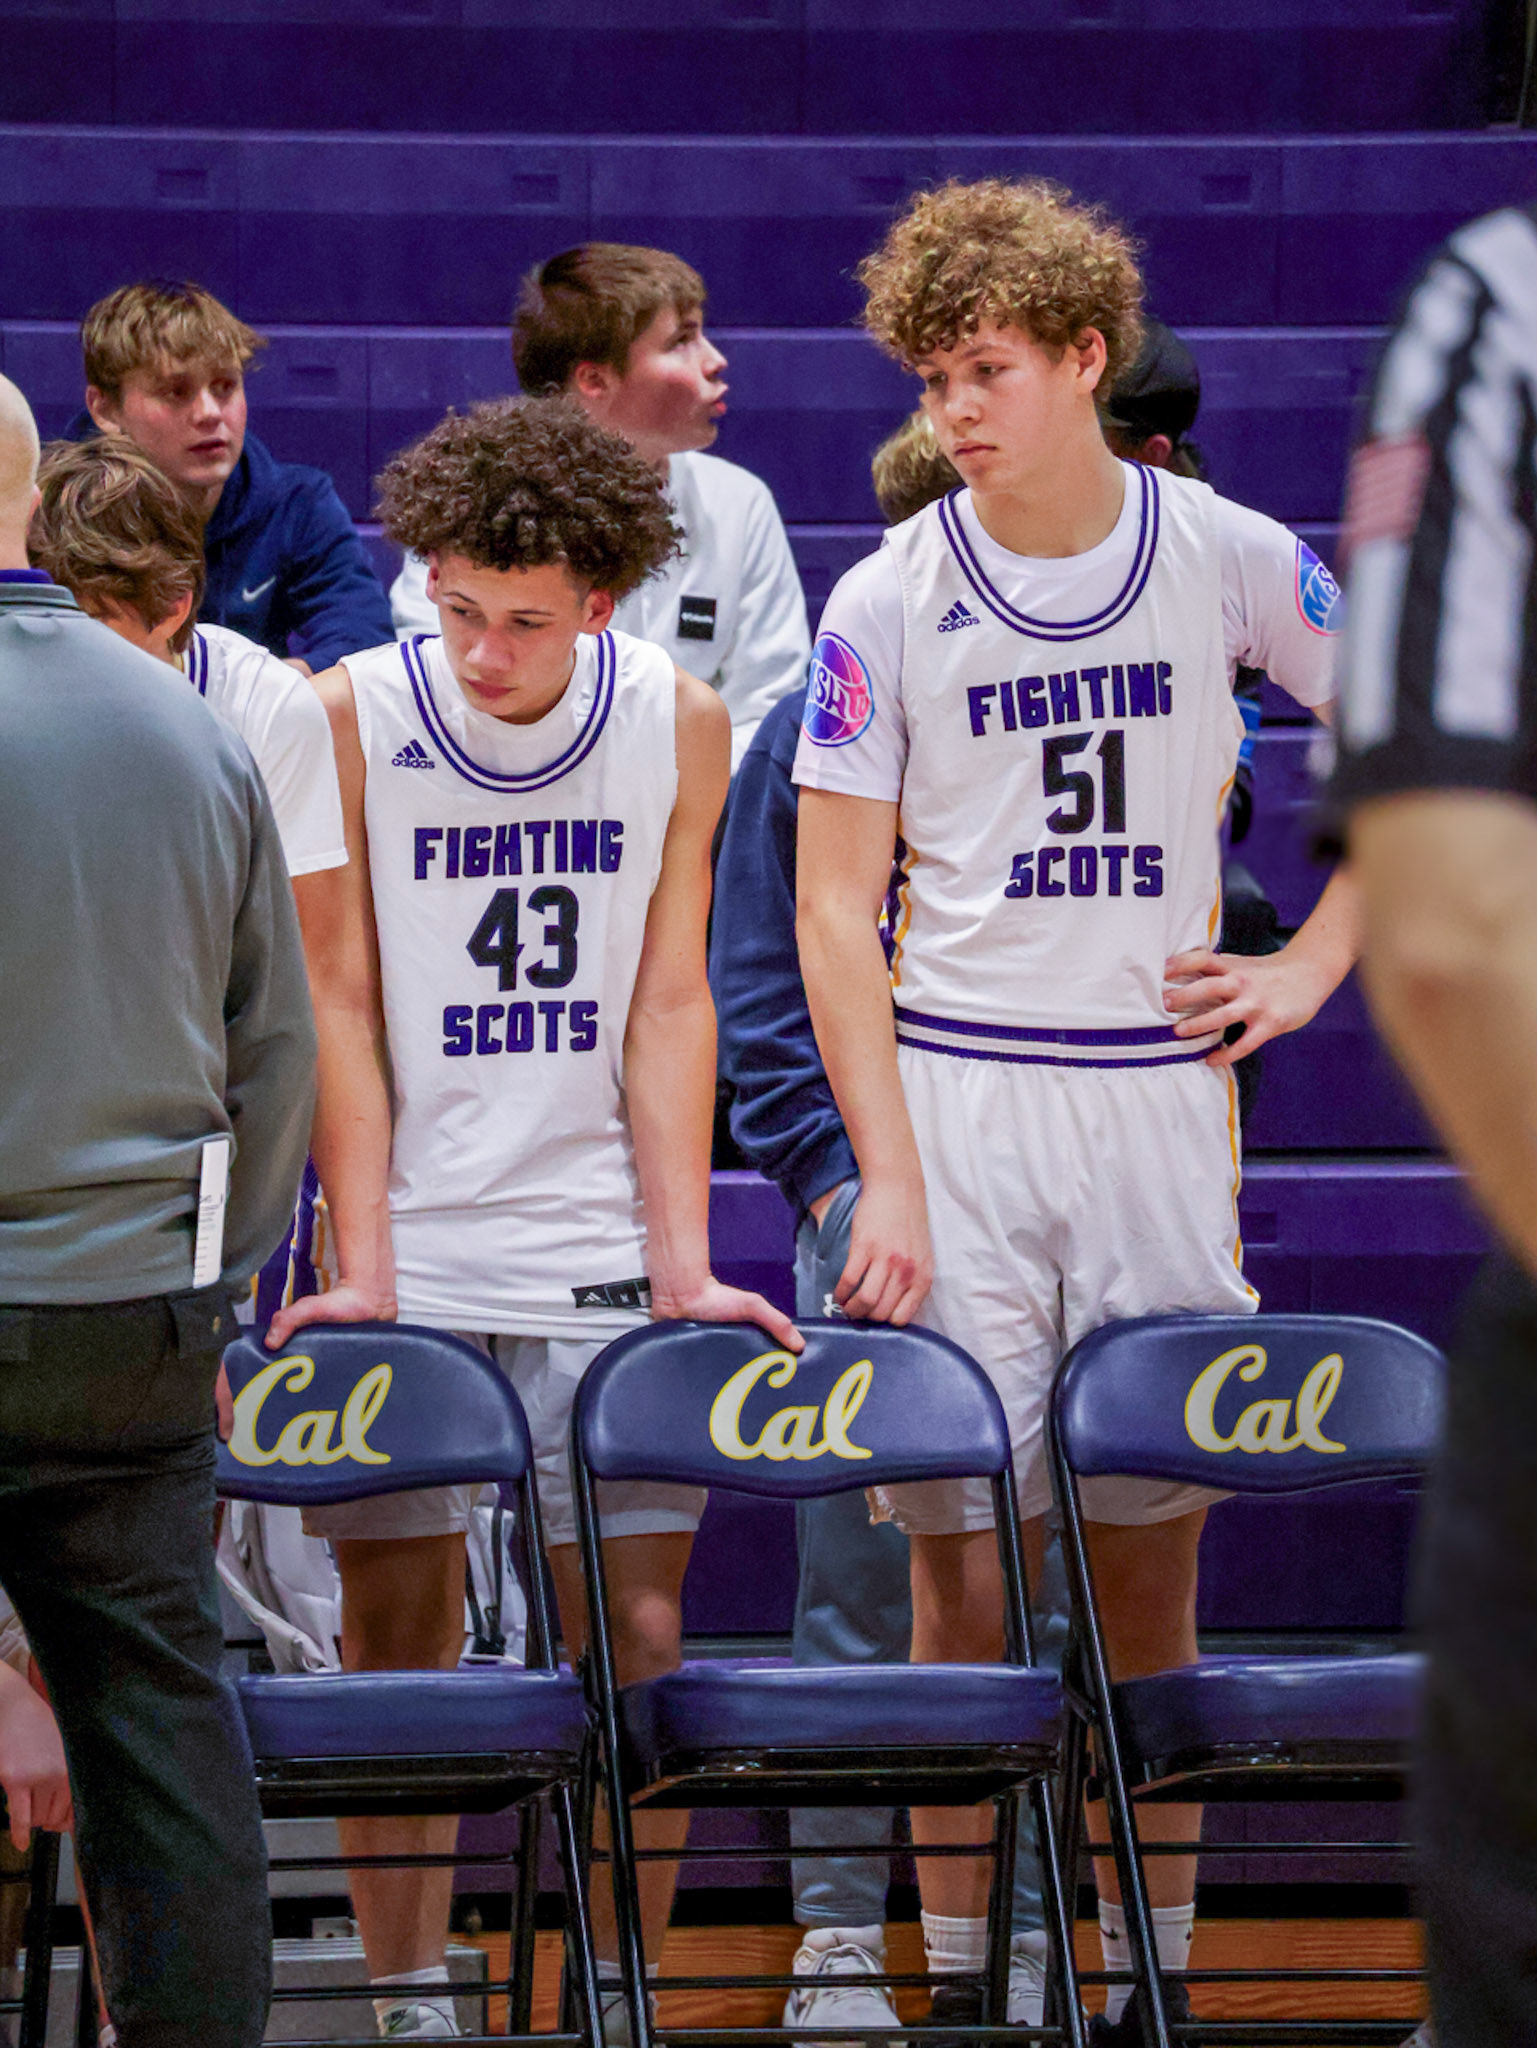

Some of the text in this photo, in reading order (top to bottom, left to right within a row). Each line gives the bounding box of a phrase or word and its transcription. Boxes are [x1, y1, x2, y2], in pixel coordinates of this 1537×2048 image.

[937, 616, 981, 633] adidas
[967, 661, 1173, 737] FIGHTING
[391, 757, 436, 769] adidas
[1041, 729, 1126, 835] 51
[414, 819, 624, 880] FIGHTING
[1004, 845, 1164, 898] SCOTS
[466, 885, 579, 991] 43
[443, 1000, 599, 1056] SCOTS
[228, 1355, 392, 1467] Cal
[709, 1351, 873, 1461] Cal
[1184, 1344, 1347, 1454] Cal
